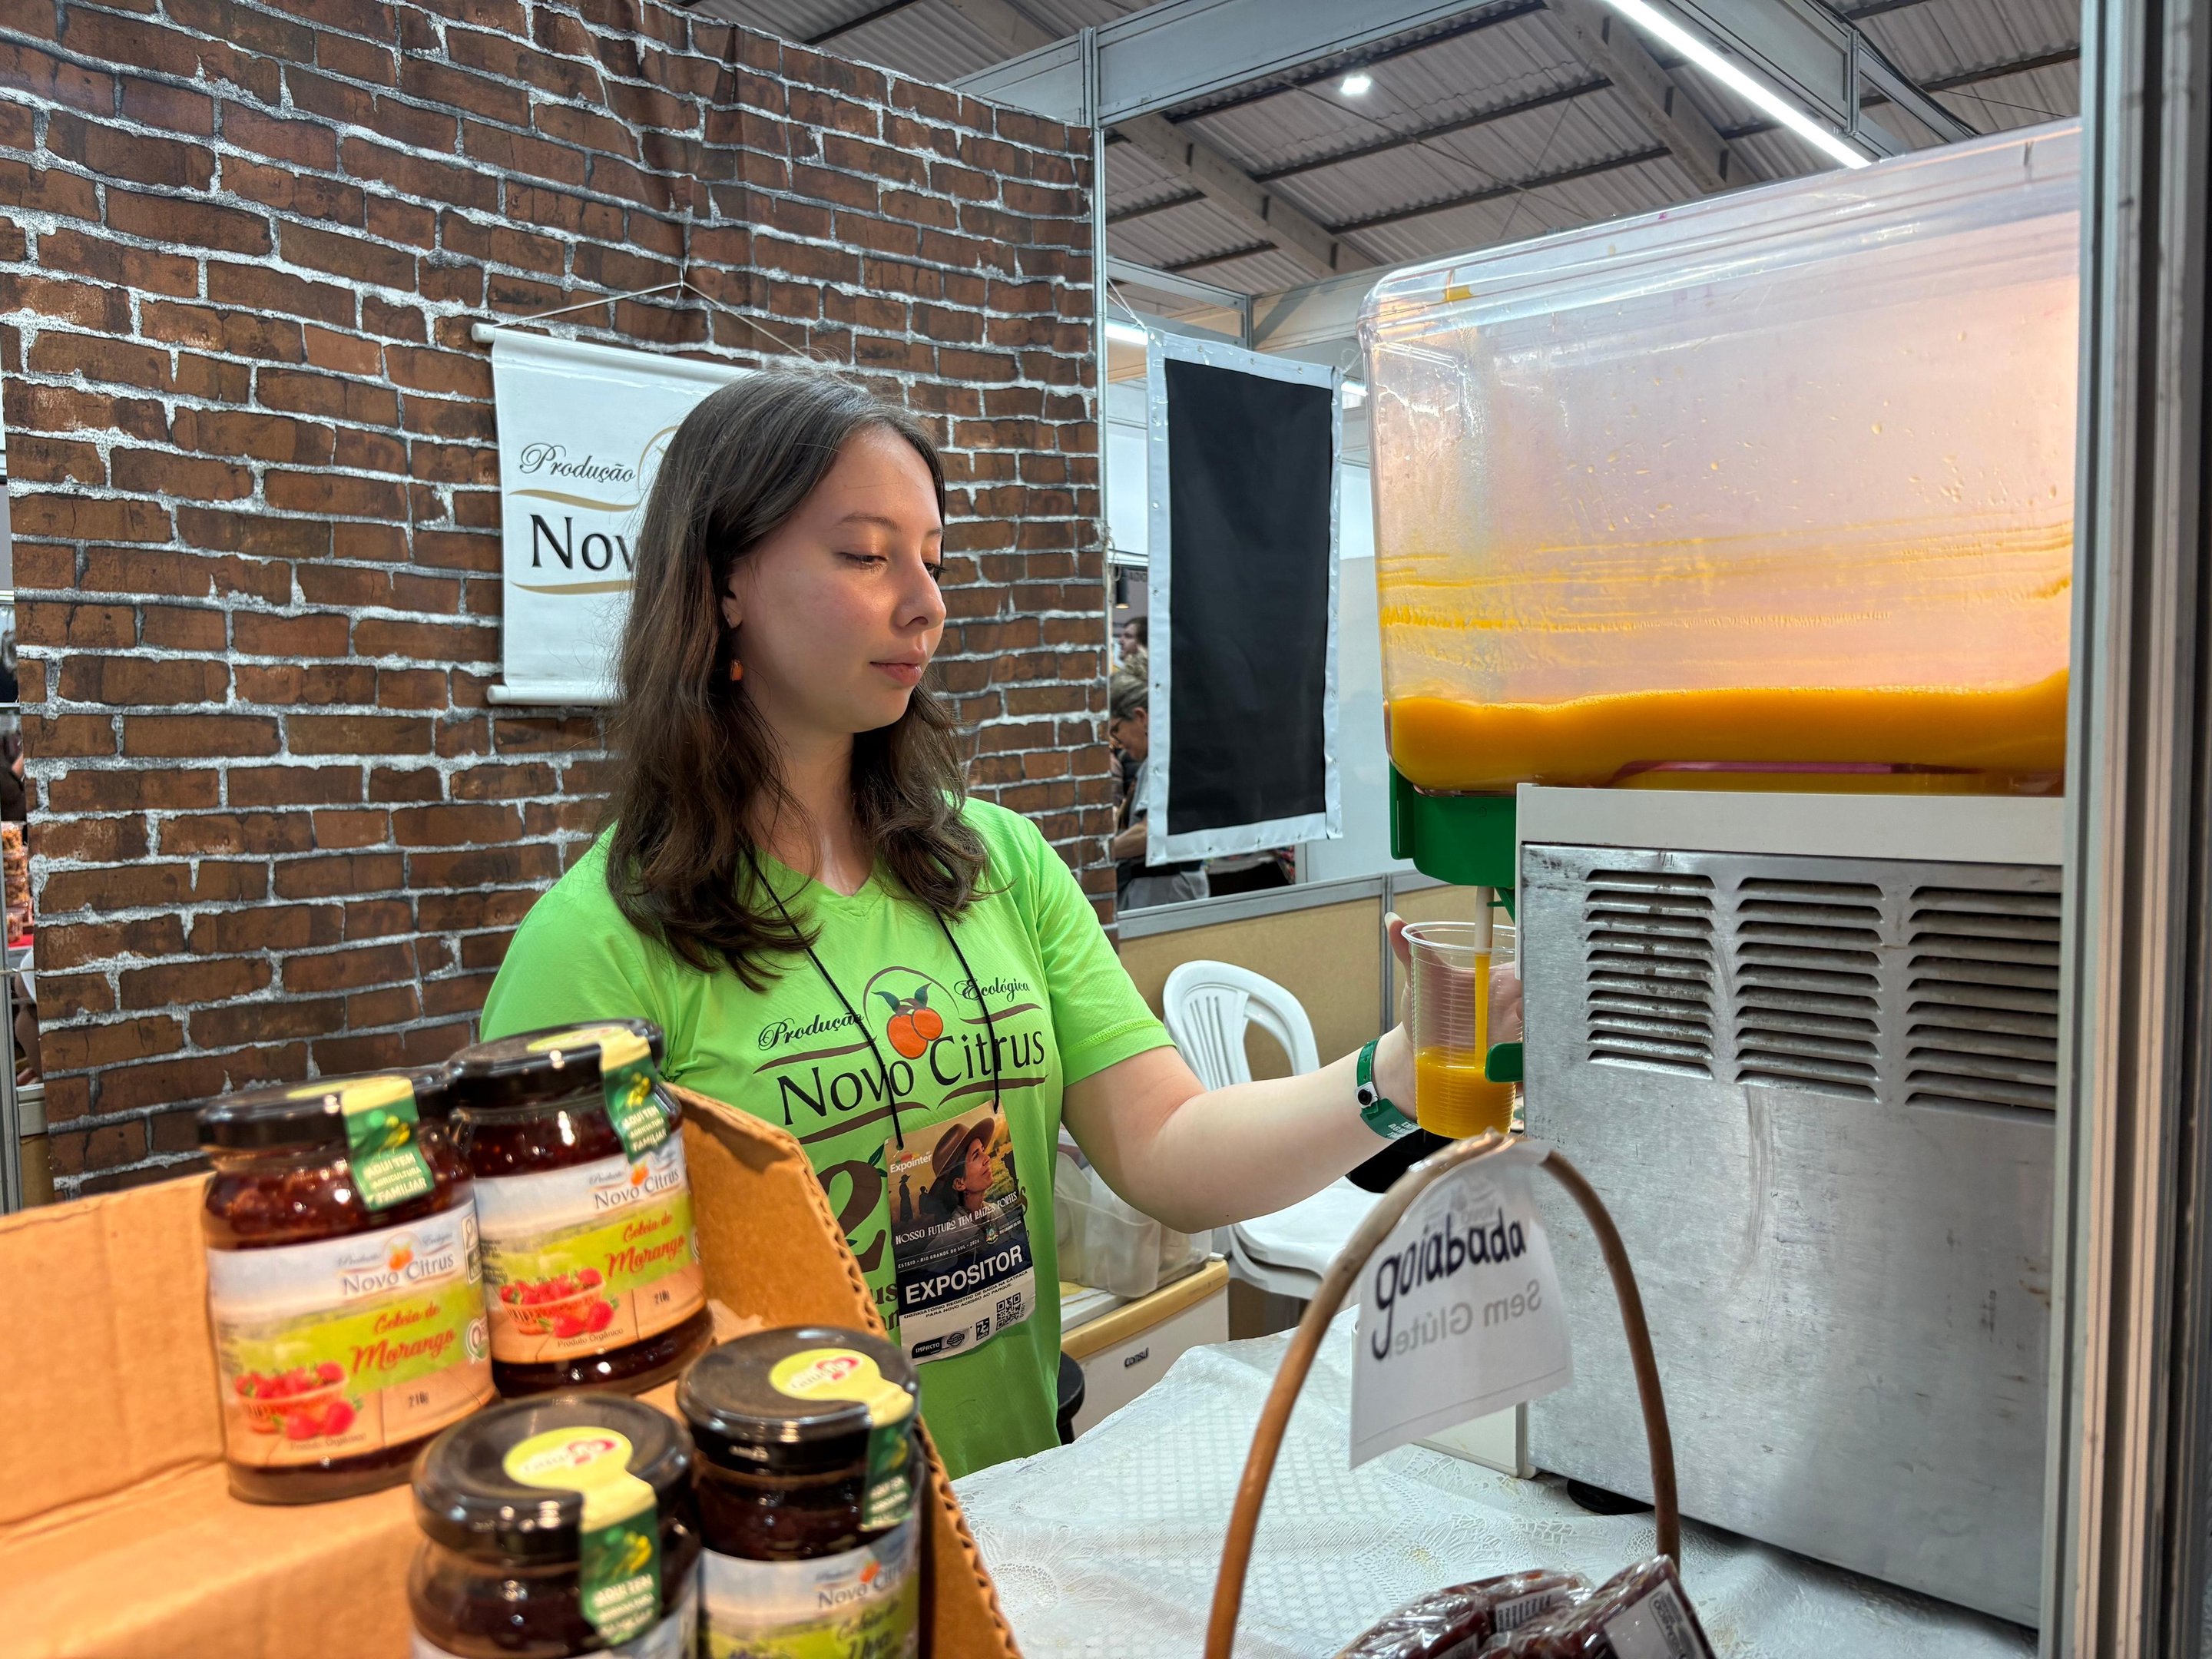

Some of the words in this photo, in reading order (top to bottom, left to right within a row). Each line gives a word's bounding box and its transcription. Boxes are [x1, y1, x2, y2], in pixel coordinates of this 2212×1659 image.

[519, 442, 636, 483] Produção
[530, 514, 640, 572] Nov
[953, 977, 1031, 1002] Ecológica
[776, 1059, 914, 1126] Novo
[929, 1030, 1045, 1086] Citrus
[889, 1154, 932, 1174] Expointer
[374, 1177, 427, 1206] FAMILIAR
[594, 1186, 640, 1209] Novo
[644, 1169, 680, 1194] Citrus
[895, 1229, 926, 1245] NOSSO
[928, 1220, 956, 1236] FUTURO
[958, 1212, 972, 1227] TEM
[997, 1191, 1018, 1209] FORTES
[343, 1271, 399, 1295] Novo
[406, 1253, 455, 1280] Citrus
[604, 1234, 686, 1279] Morango
[906, 1244, 1023, 1304] EXPOSITOR
[1372, 1207, 1526, 1360] goiabada
[926, 1310, 942, 1318] PARA
[943, 1304, 960, 1313] NOVO
[960, 1296, 982, 1307] ACESSO
[348, 1329, 455, 1376] Morango
[557, 1336, 588, 1348] Produto
[589, 1327, 624, 1345] Orgânico
[915, 1342, 941, 1355] IMPACTO
[1124, 1347, 1148, 1369] Consul
[817, 1583, 868, 1608] Novo
